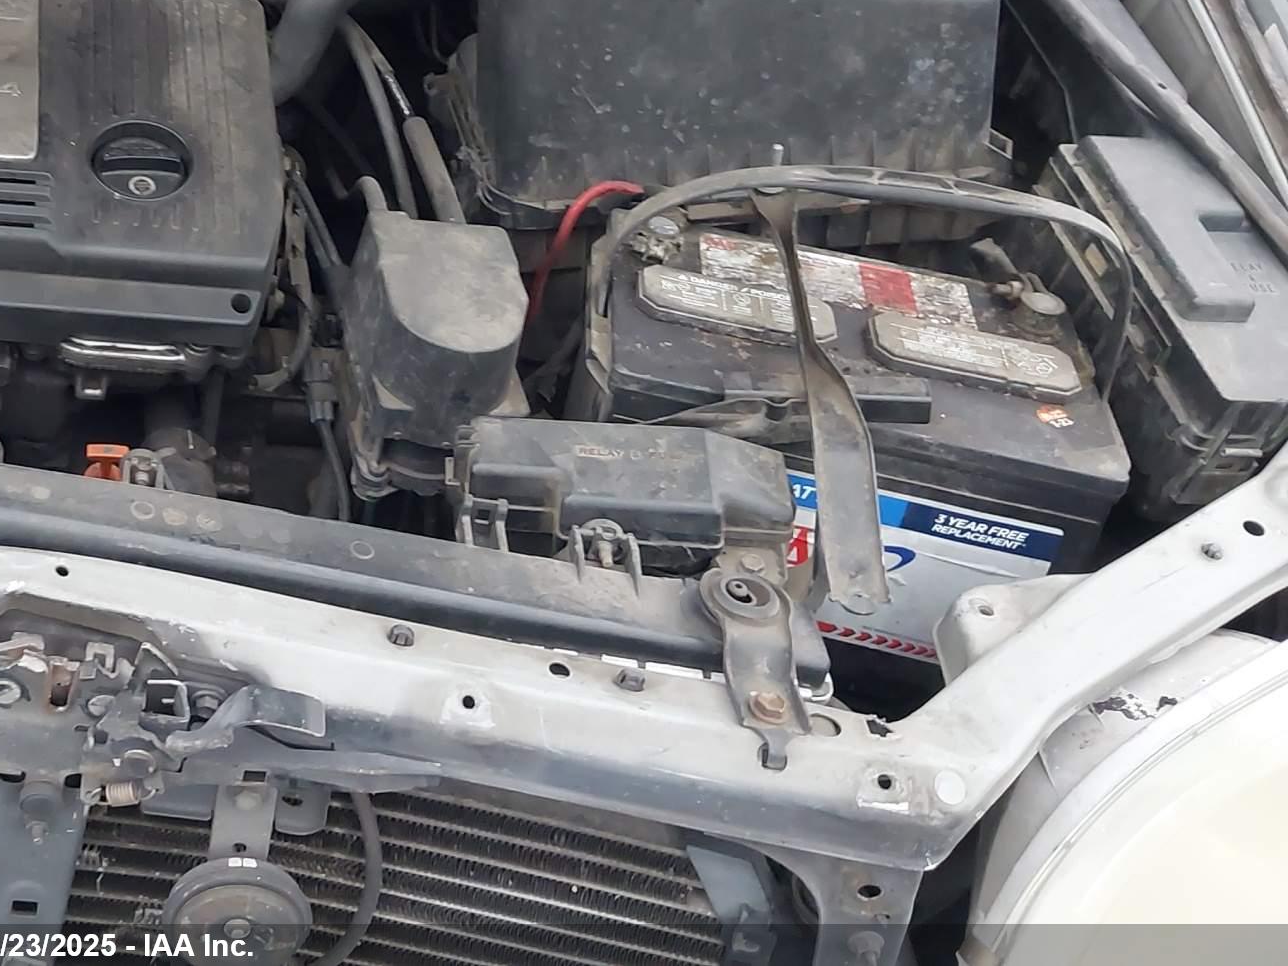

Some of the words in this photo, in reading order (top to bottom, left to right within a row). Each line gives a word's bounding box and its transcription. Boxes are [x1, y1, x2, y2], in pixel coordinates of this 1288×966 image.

[934, 513, 948, 524] 3
[948, 516, 989, 534] YEAR
[987, 525, 1030, 543] FREE
